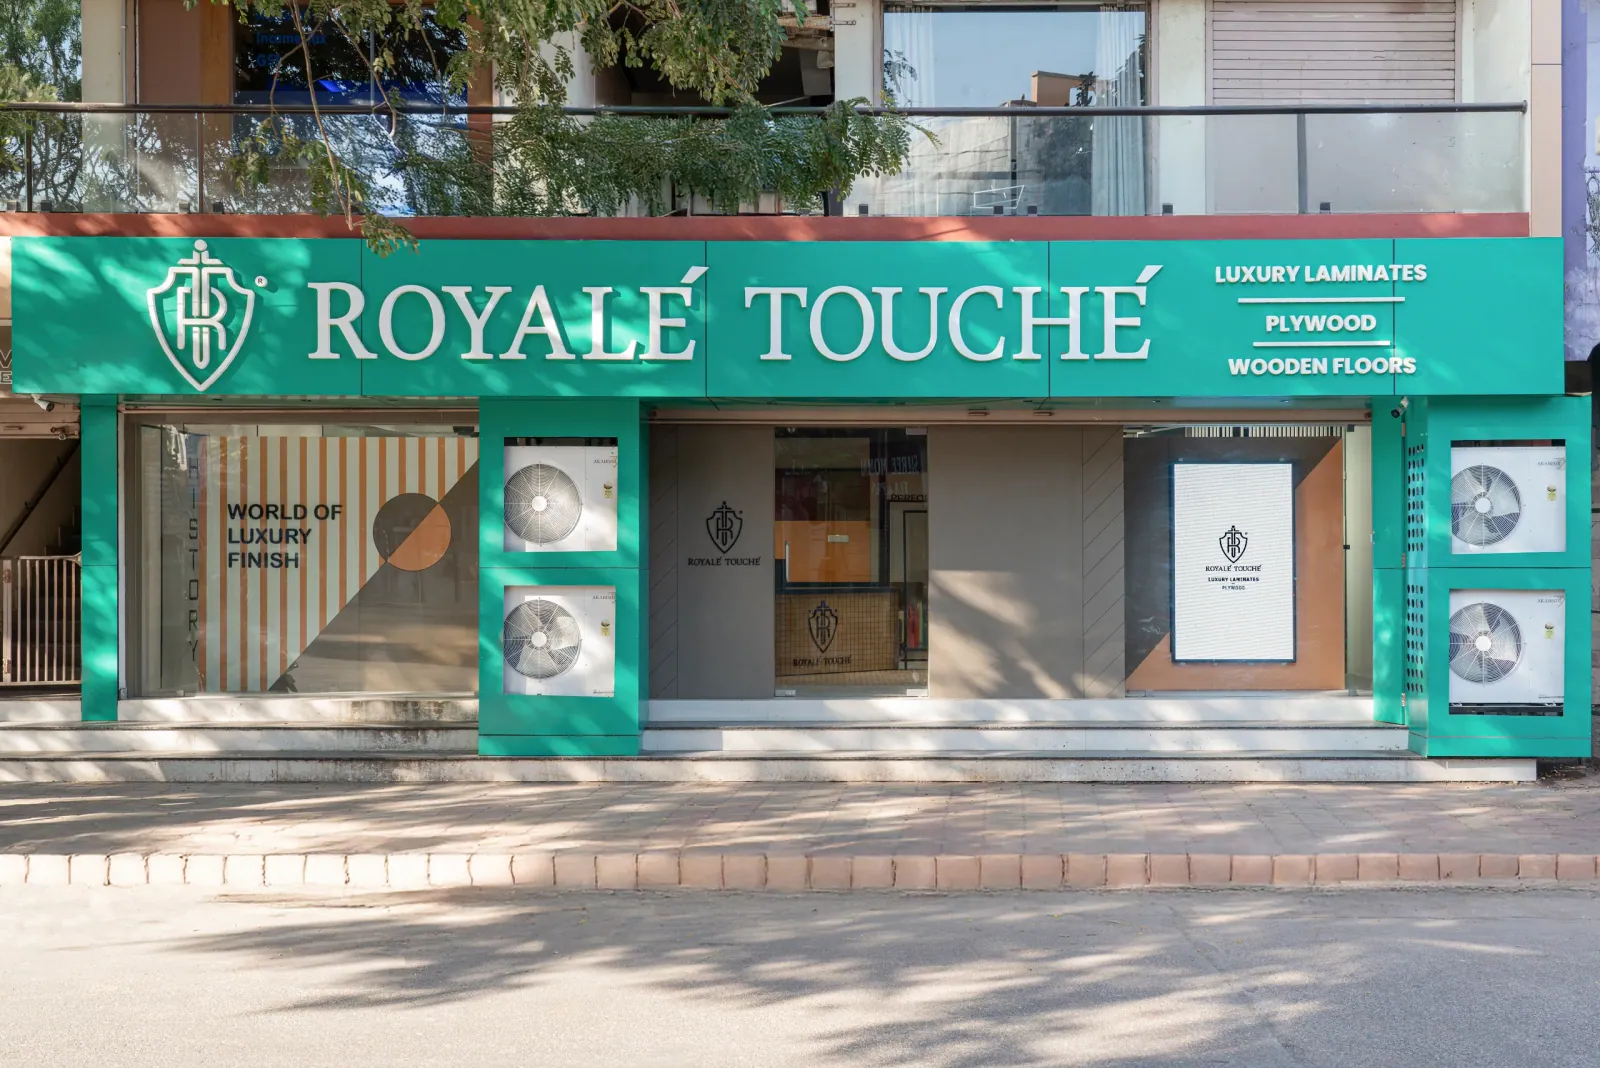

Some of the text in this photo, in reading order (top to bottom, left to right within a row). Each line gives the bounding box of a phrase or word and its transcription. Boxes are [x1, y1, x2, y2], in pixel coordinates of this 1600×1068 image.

[1215, 264, 1427, 283] LUXURY LAMINATES
[307, 264, 1164, 362] ROYALÉ TOUCHÉ
[1265, 314, 1377, 332] PLYWOOD
[1228, 356, 1417, 375] WOODEN FLOORS
[228, 503, 343, 520] WORLD OF
[228, 527, 312, 544] LUXURY
[188, 457, 200, 662] HISTORY
[228, 552, 299, 568] FINISH
[687, 556, 761, 566] ROYALÉ TOUCHÉ
